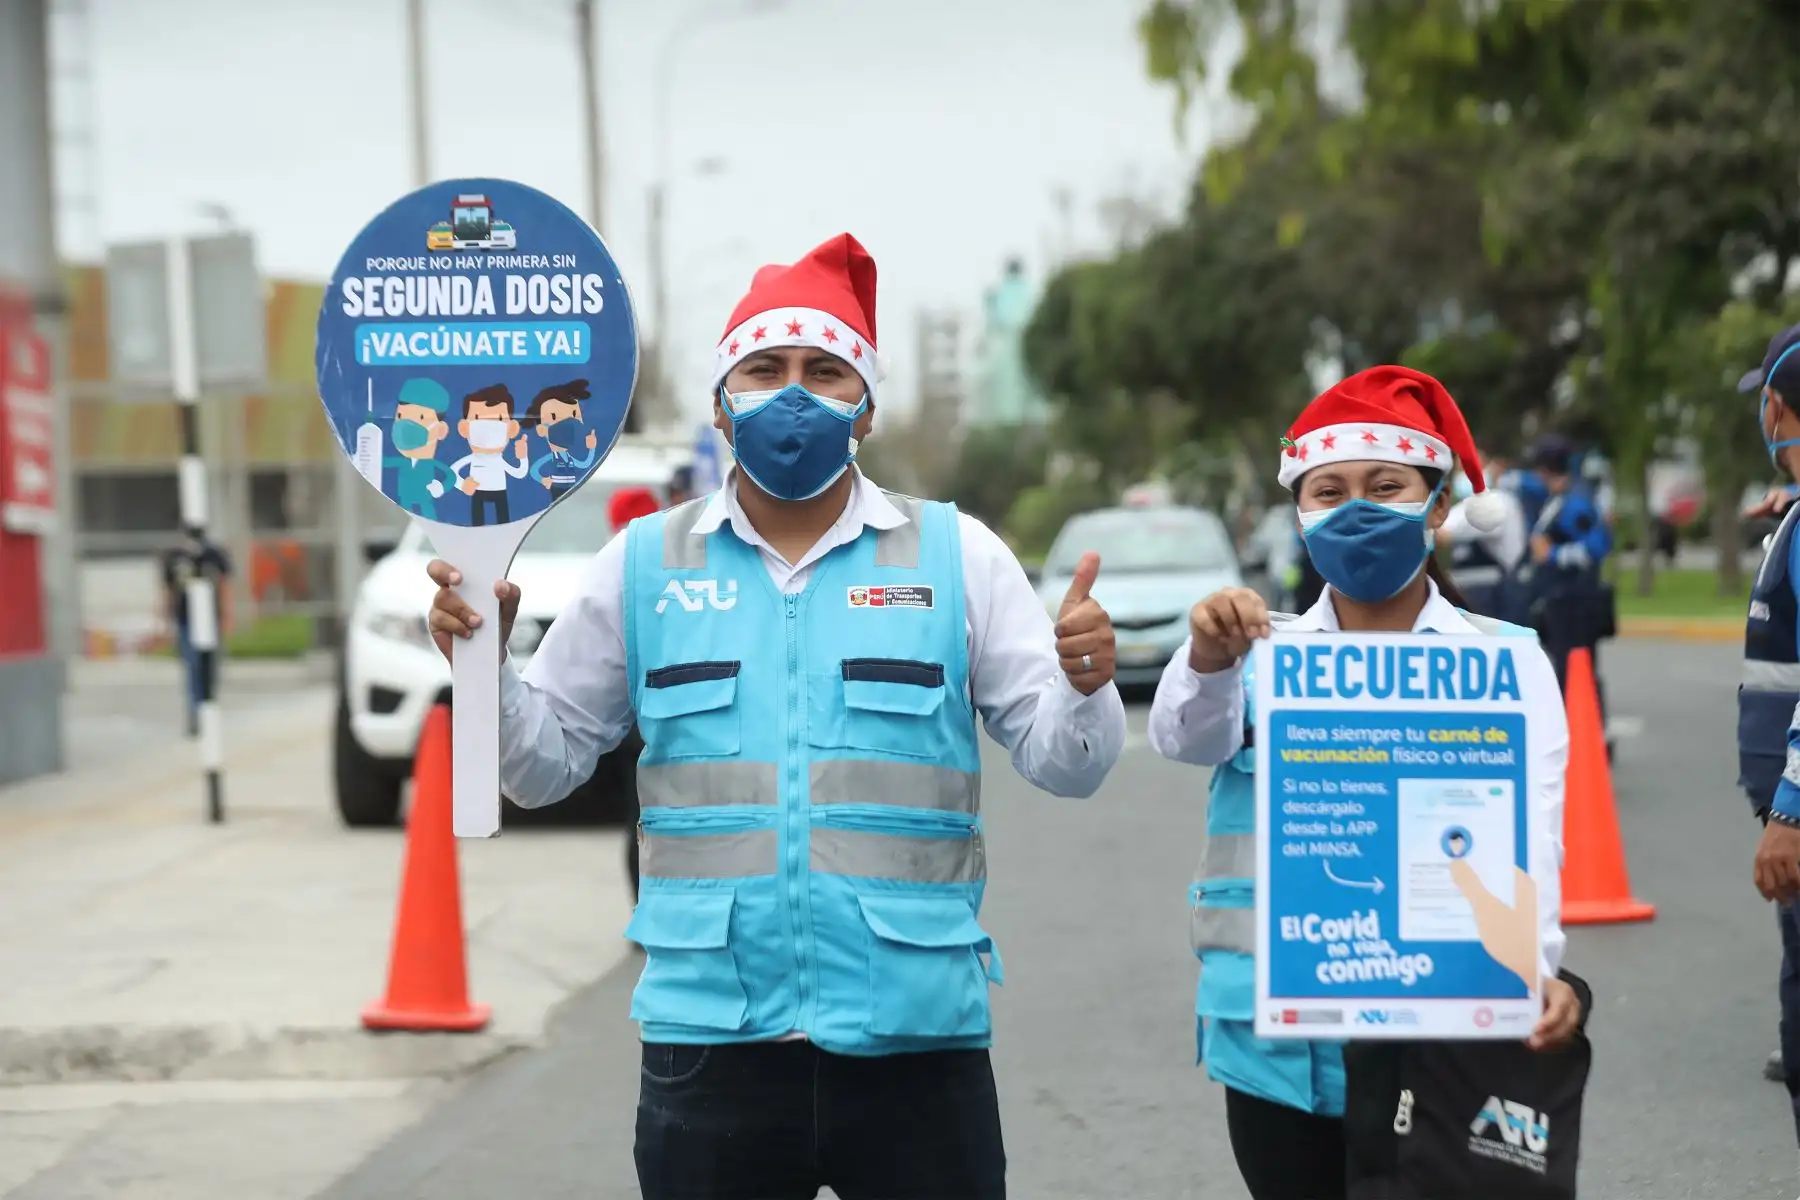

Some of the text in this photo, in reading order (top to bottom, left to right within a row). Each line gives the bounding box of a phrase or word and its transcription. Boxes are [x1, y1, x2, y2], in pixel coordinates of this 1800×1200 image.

[366, 254, 576, 271] PORQUE NO HAY PRIMERA SIN
[342, 273, 604, 317] SEGUNDA DOSIS
[362, 325, 581, 364] ¡VACÚNATE YA!
[655, 579, 737, 614] ATU
[1273, 645, 1522, 701] RECUERDA
[1286, 723, 1509, 746] lleva siempre tu carné de
[1280, 745, 1515, 766] vacunación físico o virtual
[1282, 777, 1298, 794] Si
[1298, 780, 1321, 795] no
[1321, 777, 1339, 795] lo
[1282, 799, 1366, 819] descárgalo
[1282, 820, 1379, 837] desde la APP
[1282, 841, 1307, 857] del
[1280, 908, 1381, 944] El Covid
[1315, 952, 1434, 987] conmigo
[1469, 1094, 1550, 1154] ATU
